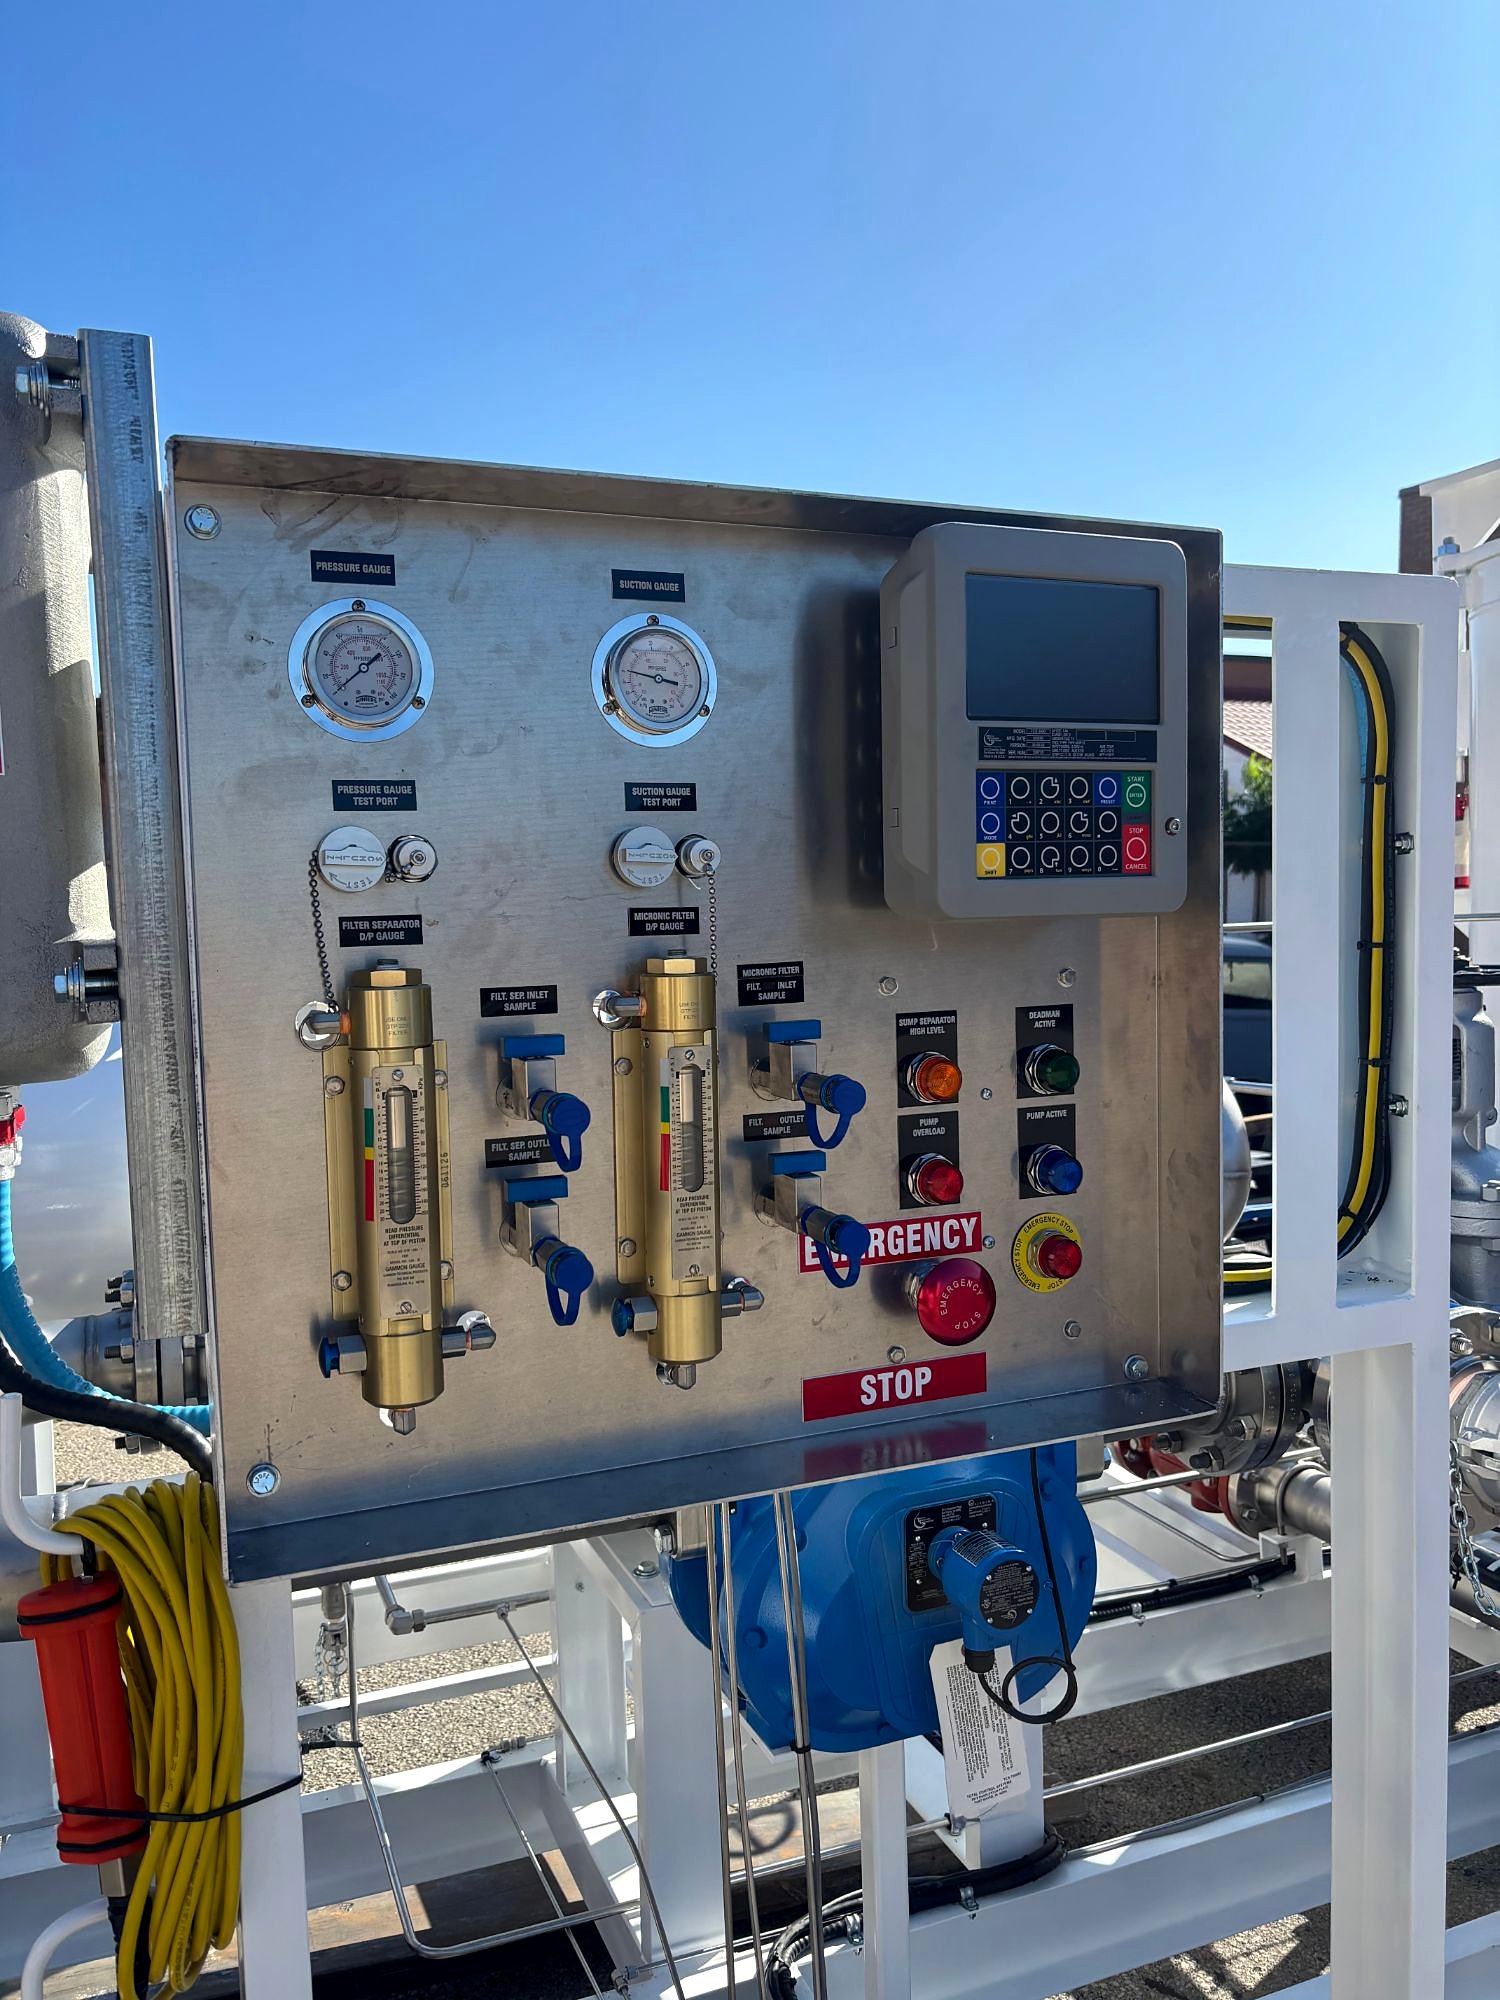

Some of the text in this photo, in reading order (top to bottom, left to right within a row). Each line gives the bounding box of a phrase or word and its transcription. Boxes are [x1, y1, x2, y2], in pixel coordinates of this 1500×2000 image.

[316, 561, 391, 575] PRESSURE GAUGE
[620, 580, 679, 592] SUCTION GAUGE
[338, 785, 412, 795] PRESSURE GAUGE
[632, 787, 690, 796] SUCTION GAUGE
[353, 797, 398, 806] TEST PORT
[642, 798, 682, 806] TEST PORT
[346, 876, 373, 888] TEST
[642, 874, 665, 884] TEST
[634, 911, 695, 921] MICRONIC FILTER
[342, 919, 420, 930] FILTER SEPARATOR
[646, 922, 684, 931] D/P GAUGE
[359, 930, 404, 941] D/P GAUGE
[742, 966, 800, 977] MICRONIC FILTER
[746, 980, 796, 991] FILT. INLET
[490, 993, 508, 1001] FILT.
[527, 990, 548, 999] INLET
[758, 992, 786, 1000] SAMPLE
[504, 1002, 536, 1011] SAMPLE
[1029, 1010, 1060, 1019] DEADMAN
[899, 1016, 955, 1026] SUMP SEPARATOR
[1034, 1020, 1056, 1028] ACTIVE
[910, 1026, 945, 1035] HIGH LEVEL
[1026, 1110, 1067, 1120] PUMP ACTIVE
[748, 1115, 804, 1127] FILT. OUTLET
[920, 1118, 939, 1127] PUMP
[763, 1126, 790, 1135] SAMPLE
[913, 1127, 945, 1136] OVERLOAD
[491, 1143, 508, 1152] FILT.
[508, 1151, 540, 1161] SAMPLE
[1023, 1216, 1074, 1234] EMERGENCY STOP
[1014, 1238, 1040, 1290] EMERGENCY STOP
[940, 1278, 983, 1330] EMERGENCY STOP
[860, 1366, 932, 1405] STOP
